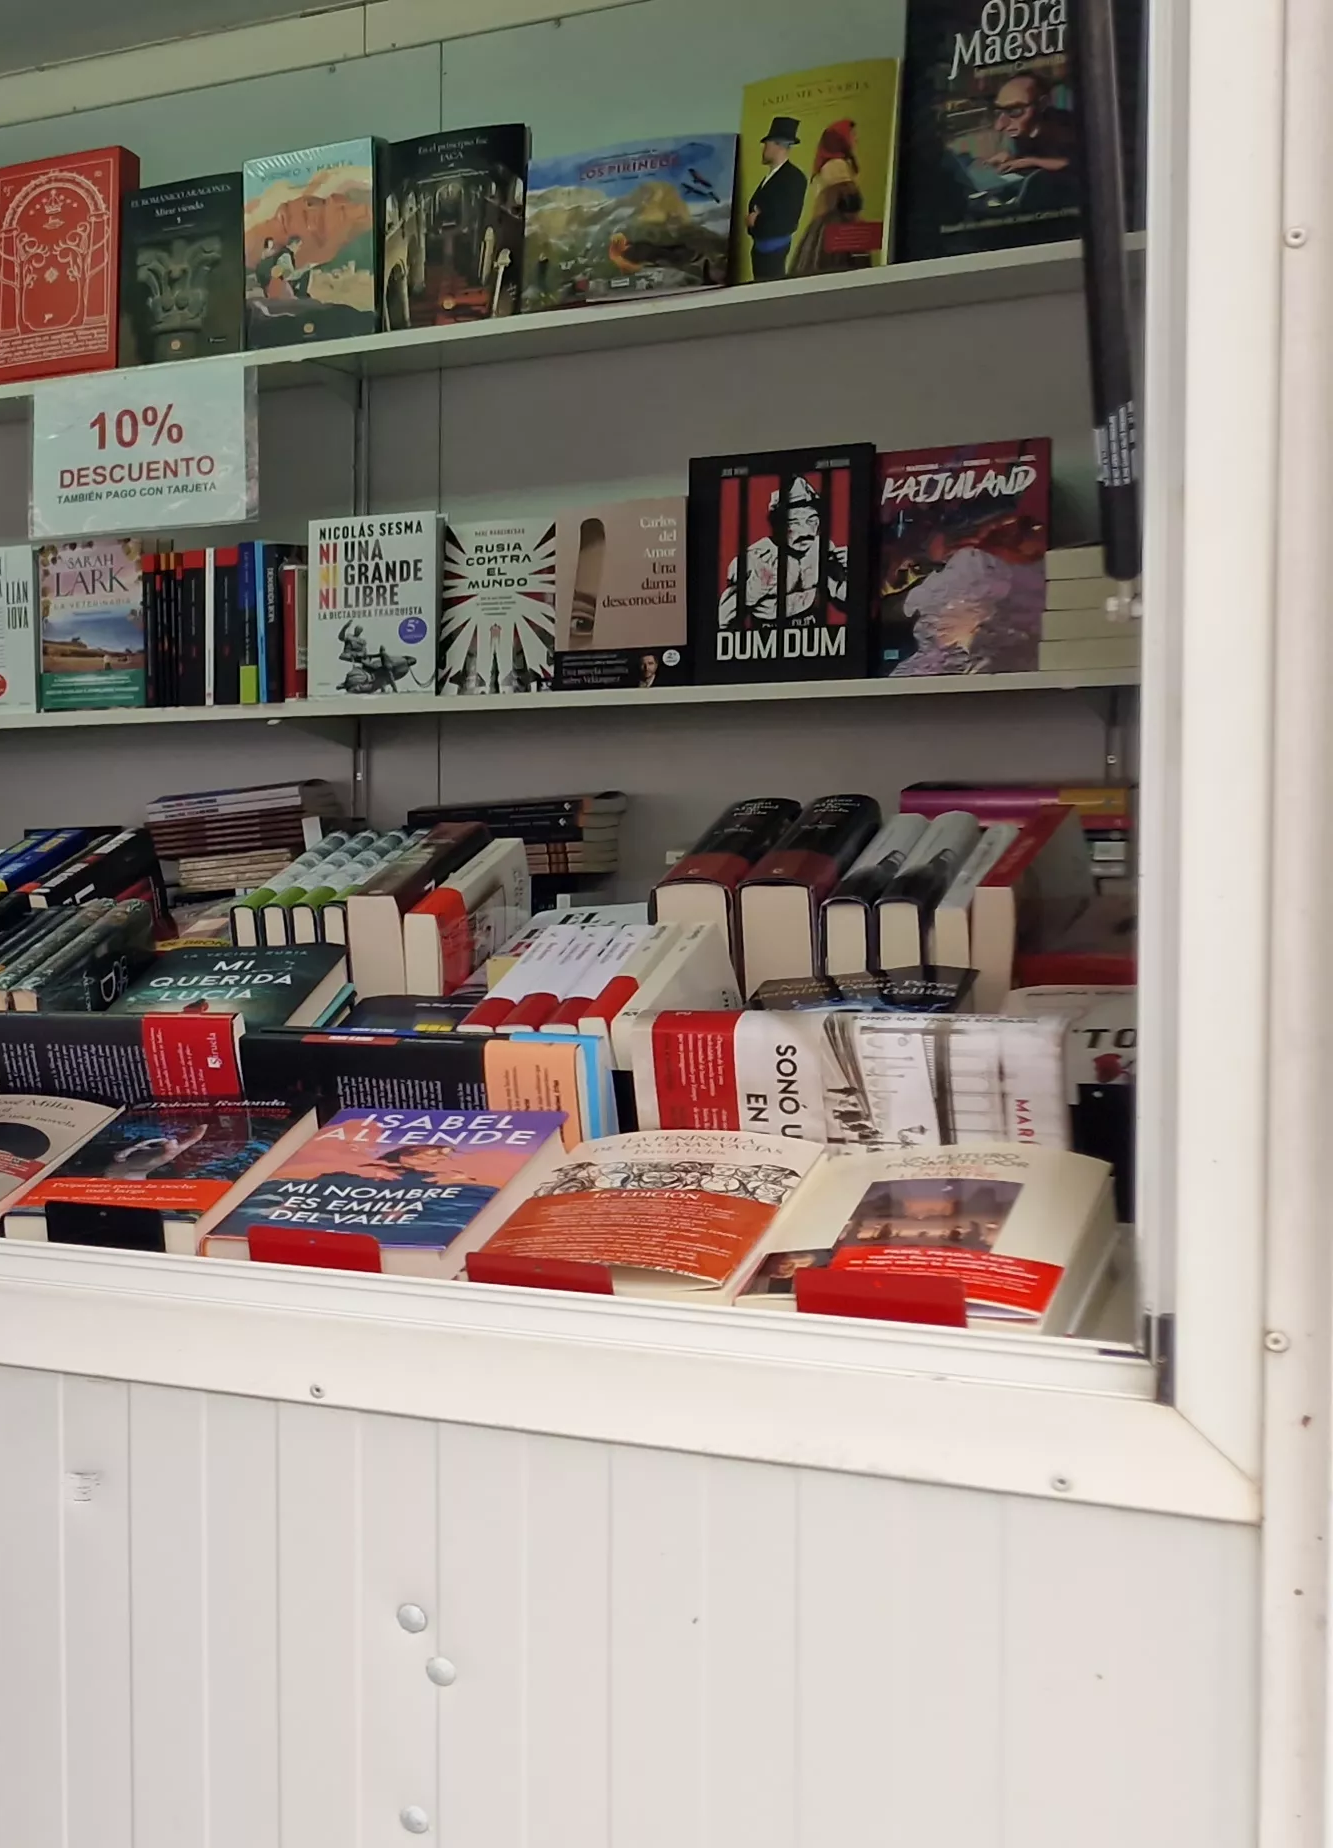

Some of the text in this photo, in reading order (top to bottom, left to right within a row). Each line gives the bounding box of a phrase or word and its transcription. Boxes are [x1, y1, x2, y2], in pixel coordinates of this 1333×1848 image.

[981, 0, 1068, 36] Obra
[437, 139, 475, 151] principio
[579, 166, 605, 181] LOS
[607, 153, 680, 176] PIRINEOS
[89, 403, 184, 451] 10%
[59, 455, 216, 490] DESCUENTO
[56, 481, 217, 505] TAMBIÉN PAGO CON TARJETA
[881, 464, 1038, 506] KAIJULAND
[639, 514, 677, 530] Carlos
[318, 519, 424, 542] NICOLÁS SESMA
[658, 529, 677, 542] del
[318, 538, 384, 565] NI UNA
[474, 541, 524, 554] RUSIA
[643, 547, 677, 560] Amor
[65, 553, 115, 570] SARAH
[651, 561, 677, 575] Una
[343, 558, 424, 586] GRANDE
[486, 567, 508, 577] EL
[54, 566, 130, 598] LARK
[467, 576, 529, 590] MUNDO
[641, 577, 677, 591] dama
[53, 597, 132, 610] LA VETERINARIA
[318, 584, 400, 611] NI LIBRE
[602, 591, 678, 609] desconocida
[317, 605, 424, 621] LA DICTADURA FRANQUISTA
[716, 625, 848, 662] DUM DUM
[212, 959, 256, 972] MI
[149, 973, 293, 989] QUERIDA
[159, 985, 253, 1002] LUCÍA
[882, 986, 957, 997] Gellida
[775, 1043, 808, 1117] SONÓ
[28, 1099, 76, 1112] Millás
[150, 1099, 287, 1109] Dolores Redondo
[745, 1093, 770, 1123] EN
[360, 1113, 516, 1131] ISABEL
[316, 1127, 537, 1146] ALLENDE
[625, 1133, 756, 1145] LA PENÍNSULA
[592, 1145, 612, 1153] DE
[616, 1143, 645, 1152] LAS
[648, 1142, 707, 1150] CASAS
[632, 1148, 679, 1156] David
[885, 1157, 1030, 1169] PROMETEDOR
[935, 1152, 1021, 1162] FUTURO
[85, 1187, 110, 1195] más
[112, 1182, 143, 1191] para
[145, 1182, 157, 1190] la
[160, 1183, 197, 1191] noche
[277, 1181, 463, 1200] MI NOMBRE
[620, 1189, 700, 1201] EDICIÓN
[283, 1195, 425, 1213] ES EMILIA
[268, 1209, 419, 1226] DEL VALLE
